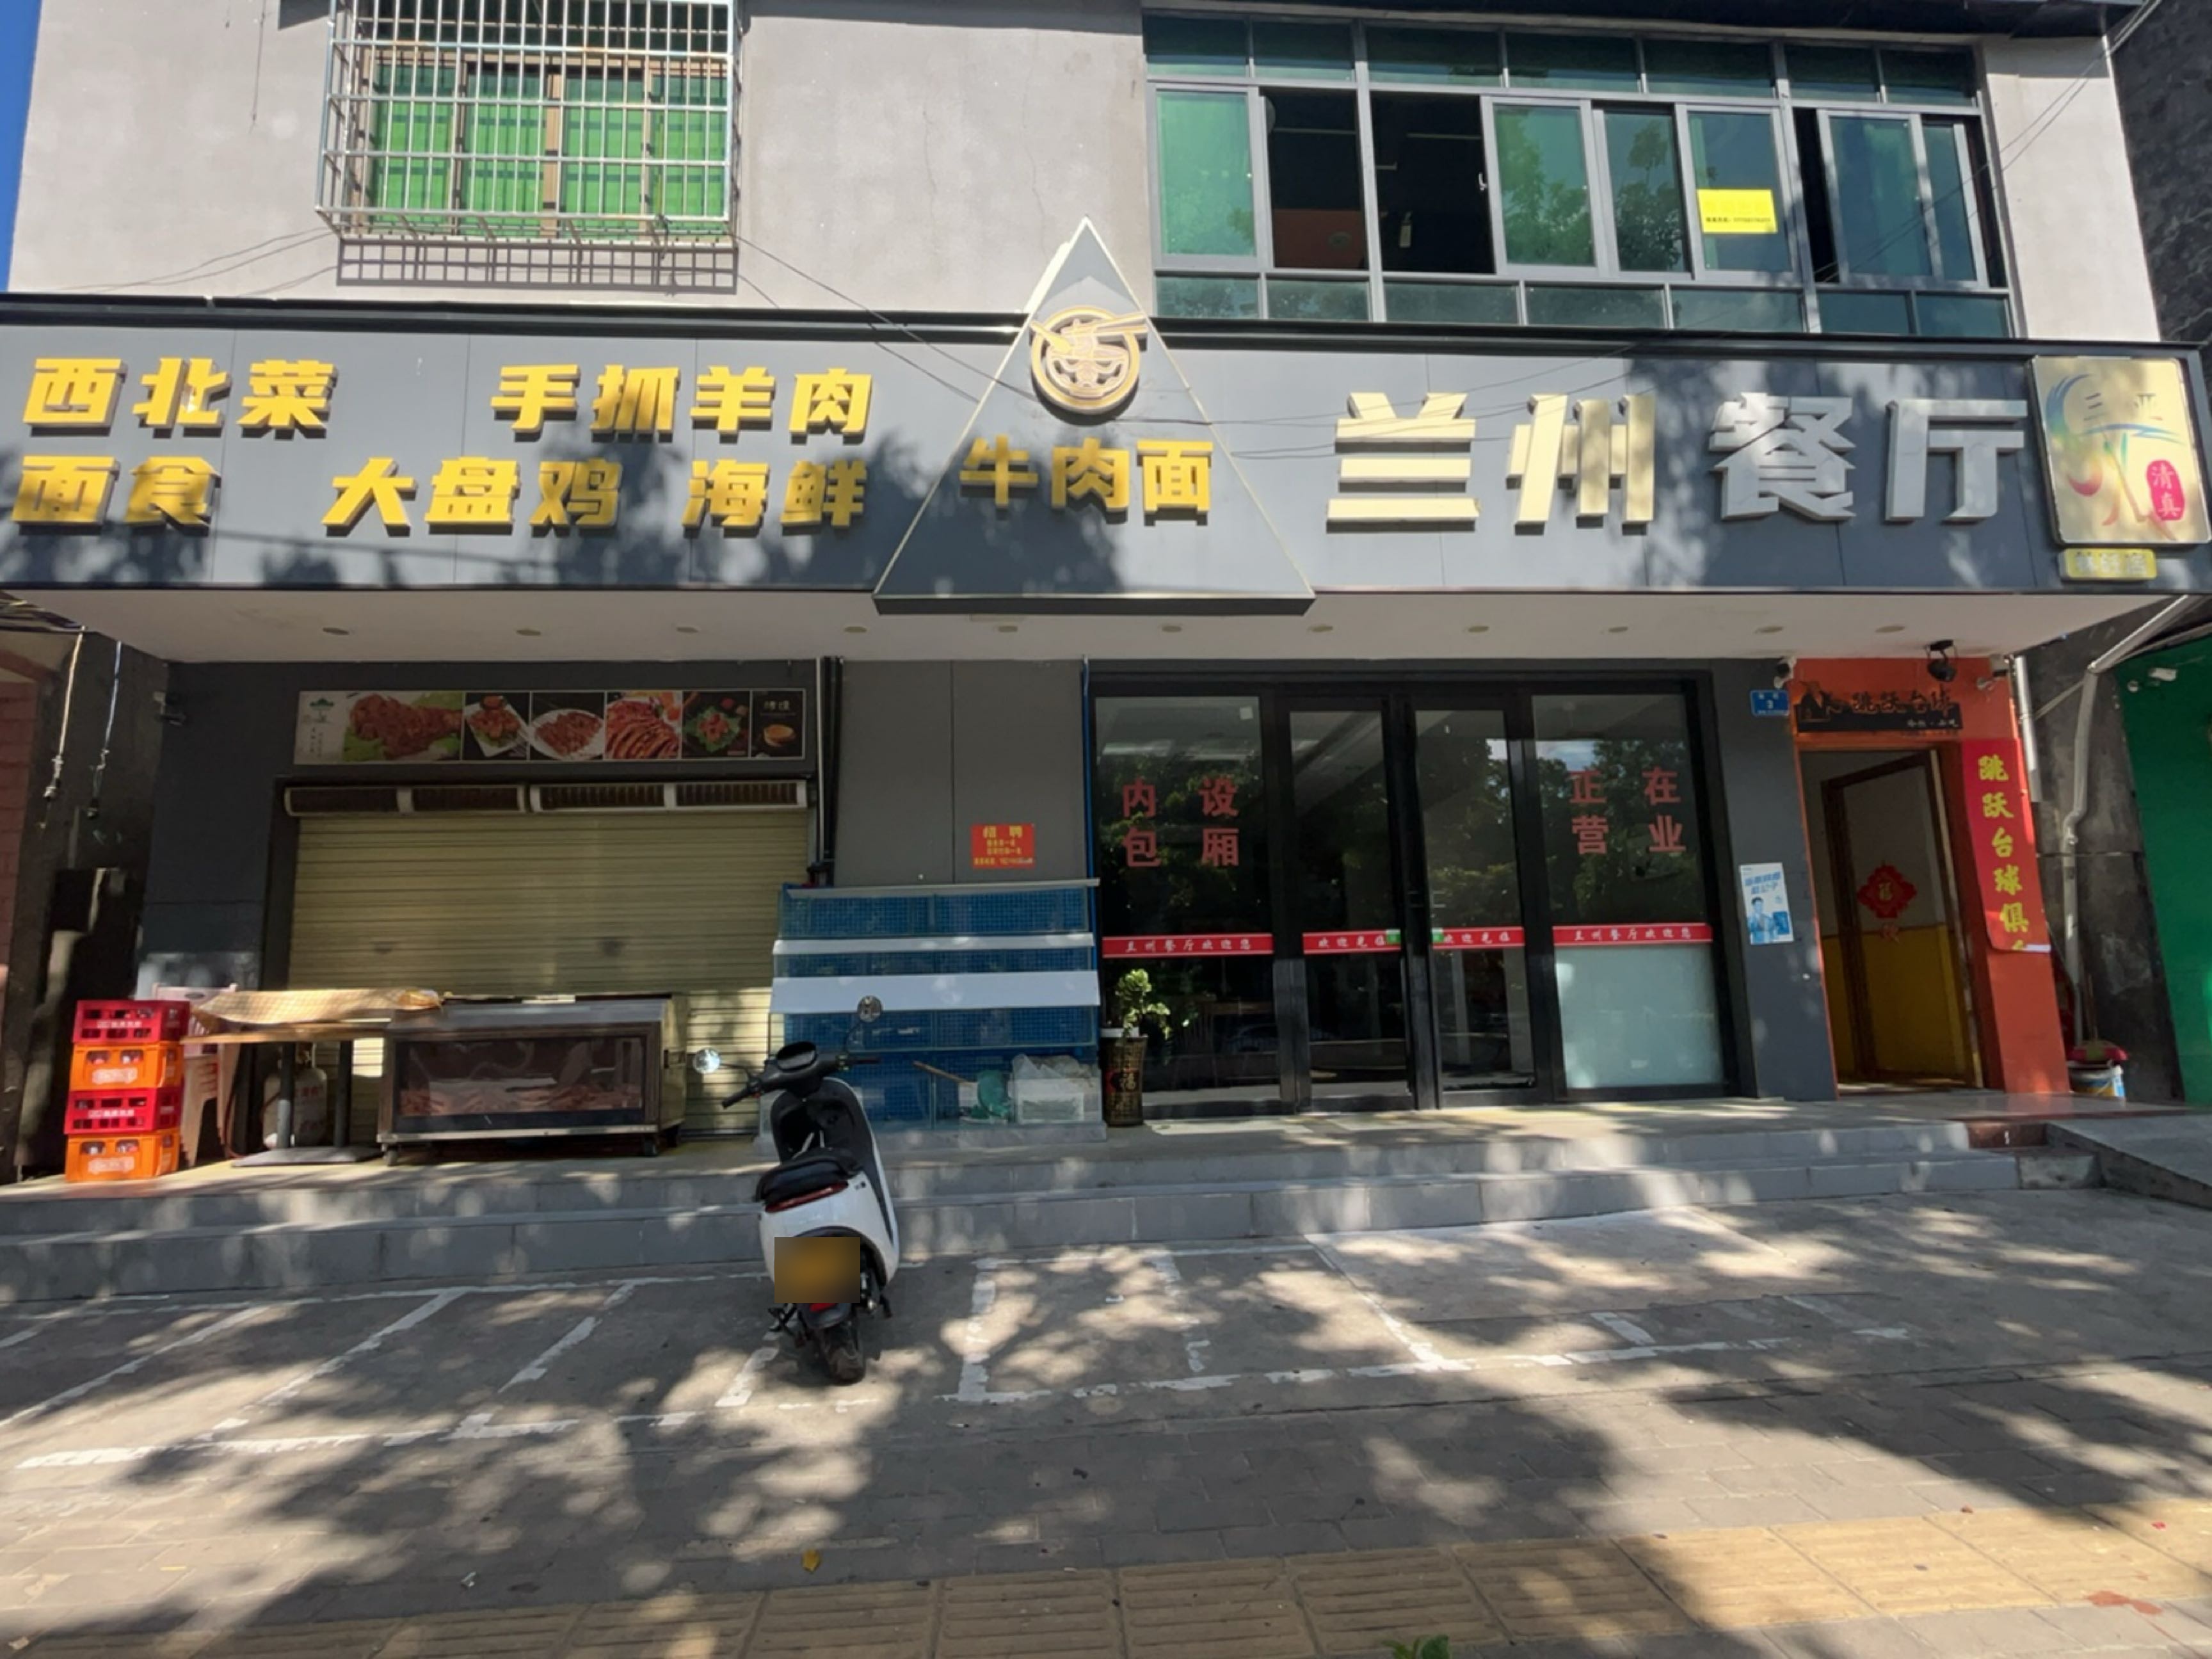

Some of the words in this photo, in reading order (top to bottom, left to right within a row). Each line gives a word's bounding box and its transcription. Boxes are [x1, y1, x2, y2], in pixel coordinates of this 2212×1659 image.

[24, 358, 338, 429] 西北菜
[490, 364, 873, 434] 手抓羊肉
[14, 455, 221, 527] 面食
[321, 457, 623, 529] 大盘鸡
[683, 459, 869, 529] 海鲜
[960, 435, 1213, 513] 牛肉面
[1327, 392, 2028, 526] 兰州餐厅
[2151, 464, 2181, 517] 清真
[1123, 776, 1238, 817] 内设
[1569, 767, 1680, 806] 正在
[1121, 828, 1239, 867] 包厢
[1571, 815, 1686, 854] 营业
